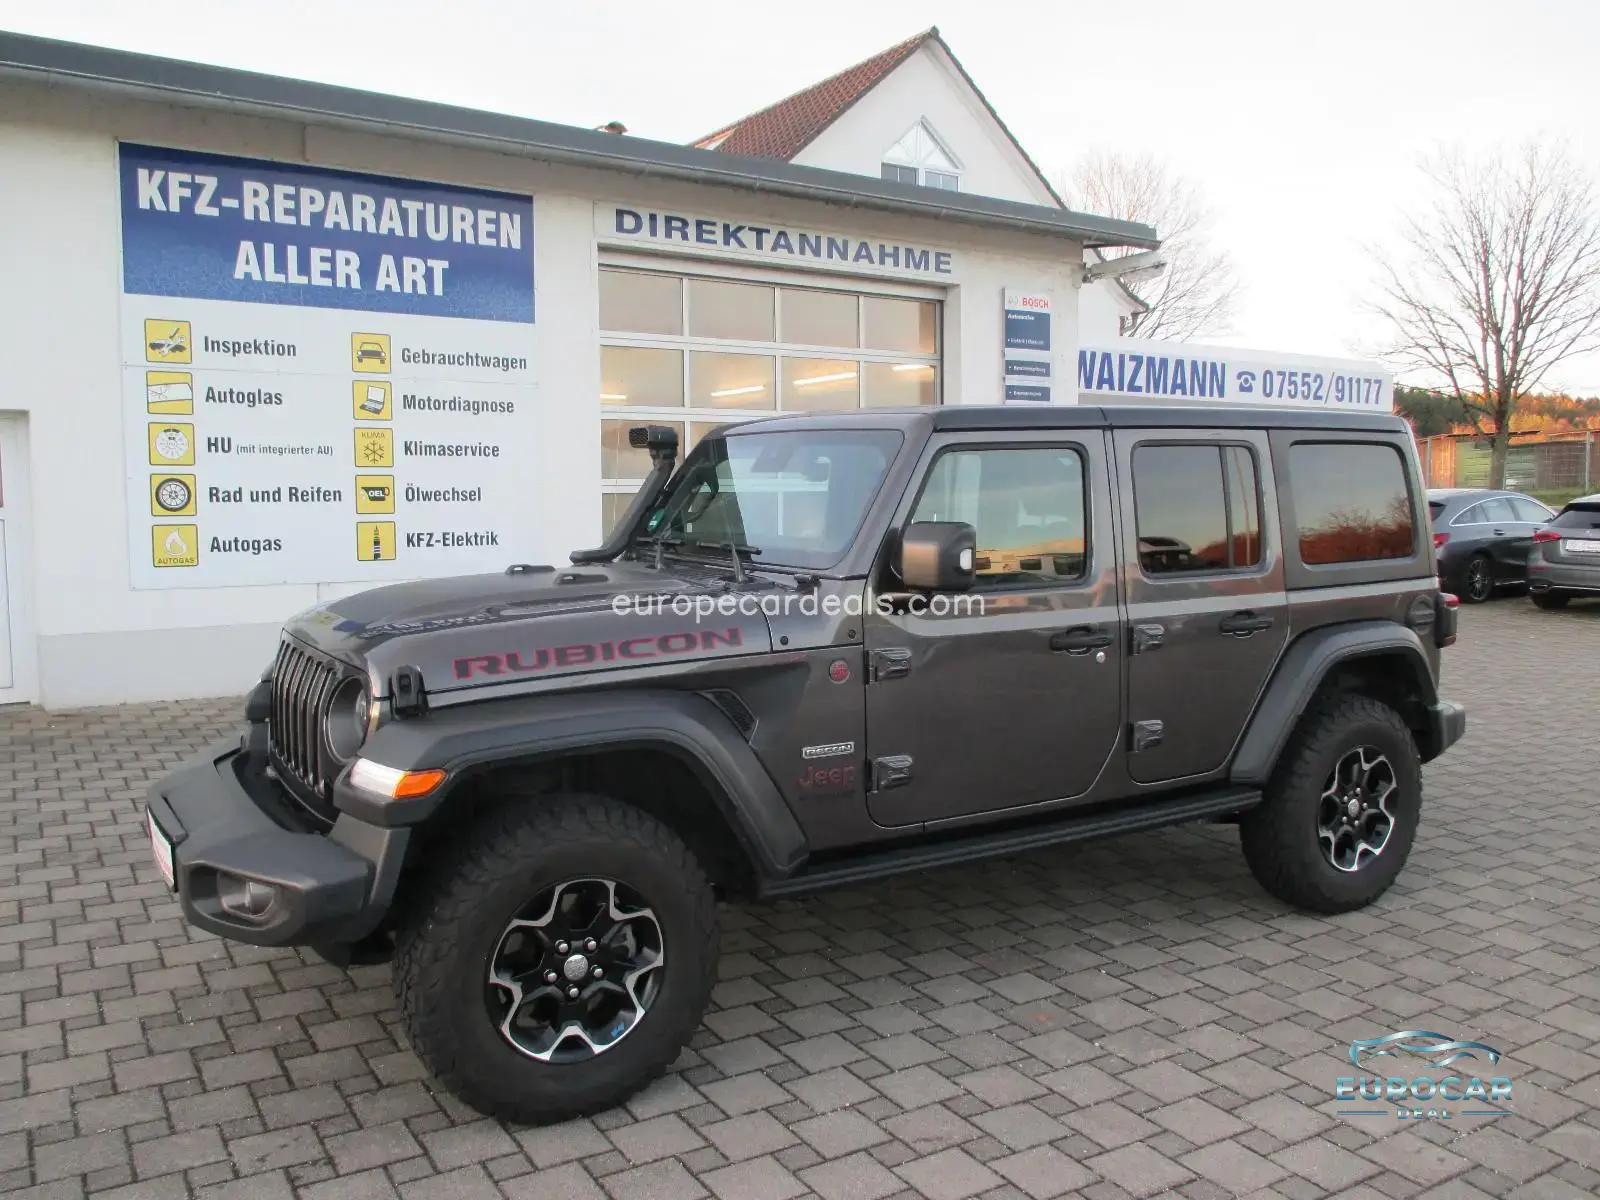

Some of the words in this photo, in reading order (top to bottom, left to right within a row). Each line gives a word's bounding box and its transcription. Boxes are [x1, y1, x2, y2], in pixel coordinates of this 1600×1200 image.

[136, 168, 521, 250] KFZ-REPARATUREN
[615, 208, 952, 274] DIREKTANNAHME
[233, 240, 361, 289] ALLER
[375, 254, 449, 296] ART
[1022, 297, 1049, 309] BOSCH
[204, 335, 297, 357] Inspektion
[401, 347, 528, 372] Gebrauchtwagen
[1078, 350, 1226, 398] WAIZMANN
[1262, 369, 1383, 405] 07552/91177
[205, 386, 283, 408] Autoglas
[402, 394, 515, 415] Motordiagnose
[361, 431, 386, 439] KLIMA
[207, 436, 232, 453] HU
[236, 444, 256, 455] (mit
[259, 444, 314, 456] integrierter
[317, 445, 334, 456] AU)
[404, 440, 500, 457] Klimaservice
[208, 486, 243, 503] Rad
[250, 486, 282, 503] und
[288, 486, 342, 503] Reifen
[405, 482, 482, 502] Ölwechsel
[210, 536, 282, 555] Autogas
[406, 531, 499, 548] KFZ-Elektrik
[157, 557, 195, 565] AUTOGAS
[452, 627, 744, 680] RUBICON
[797, 765, 855, 790] Jeep
